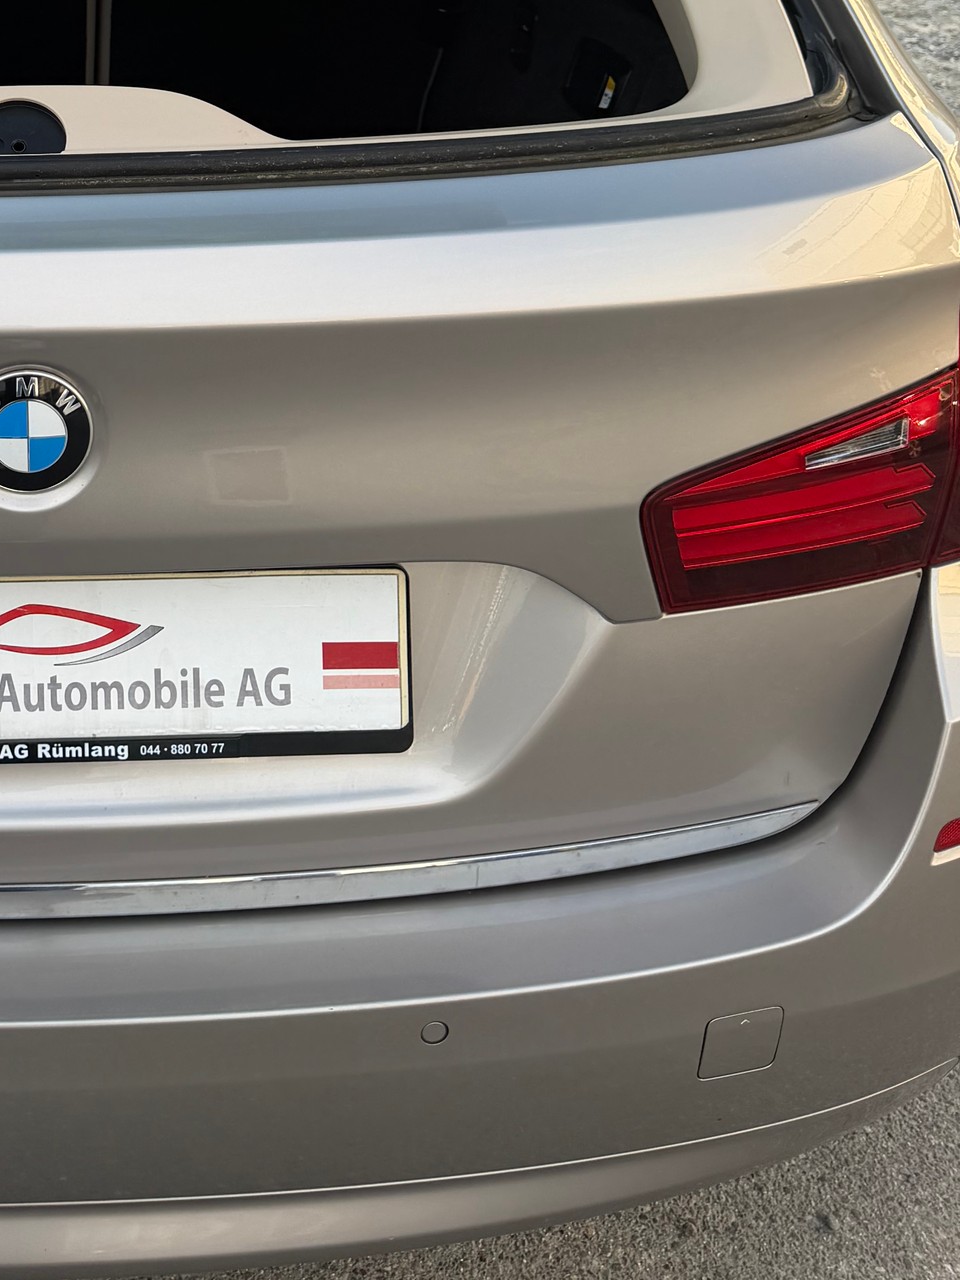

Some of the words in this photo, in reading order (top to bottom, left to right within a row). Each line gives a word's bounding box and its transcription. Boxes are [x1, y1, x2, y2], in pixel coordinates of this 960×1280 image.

[235, 666, 292, 708] AG
[0, 744, 29, 759] AG
[38, 742, 129, 760] Rümlang
[140, 744, 161, 756] 044
[171, 743, 192, 756] 880
[194, 743, 209, 755] 70
[211, 742, 225, 754] 77
